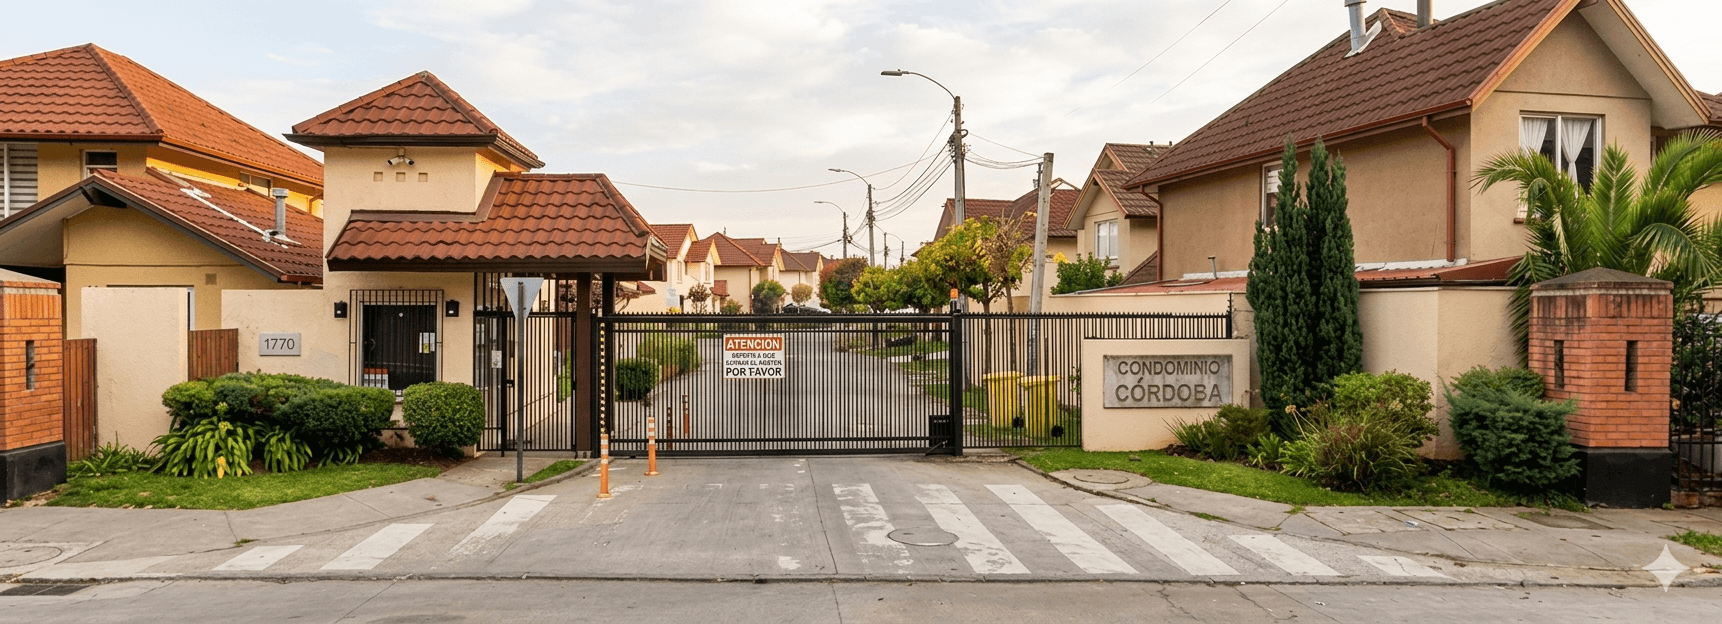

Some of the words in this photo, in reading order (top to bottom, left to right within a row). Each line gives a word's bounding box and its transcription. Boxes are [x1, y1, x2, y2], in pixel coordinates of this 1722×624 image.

[264, 338, 295, 350] 1770
[726, 339, 780, 350] ATENCION
[725, 367, 747, 376] POR
[748, 367, 782, 376] FAVOR
[1118, 360, 1220, 376] CONDOMINIO
[1115, 376, 1223, 403] CÓRDOBA
